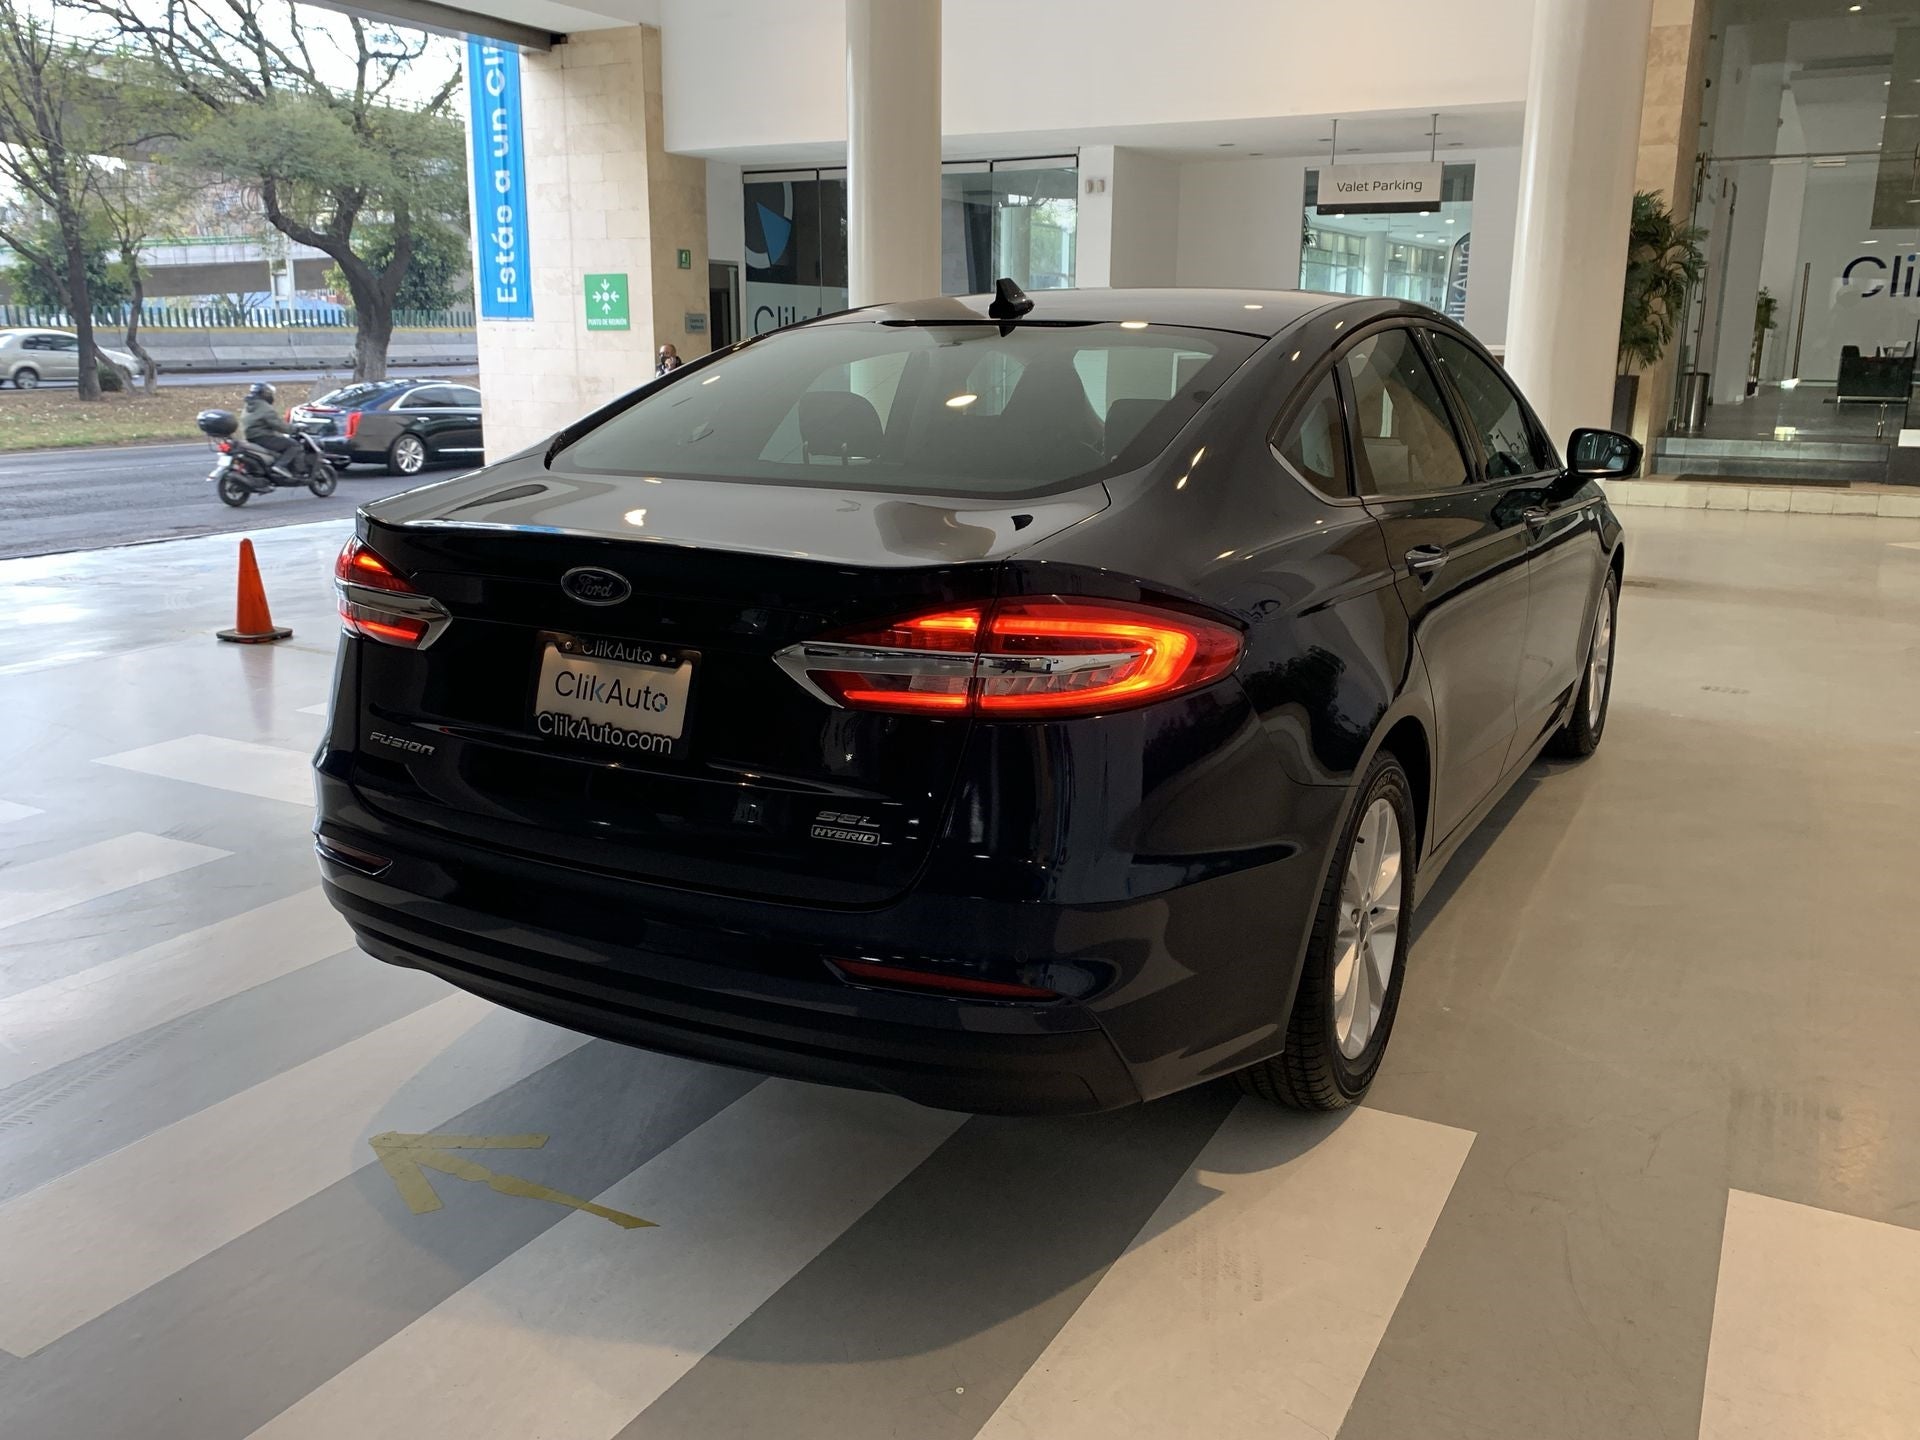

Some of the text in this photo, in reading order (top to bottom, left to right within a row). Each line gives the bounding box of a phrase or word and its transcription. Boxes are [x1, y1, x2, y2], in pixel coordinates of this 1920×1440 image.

[491, 108, 509, 158] un
[495, 169, 511, 194] a
[1336, 180, 1424, 193] Valet Parking
[491, 205, 518, 303] Estás
[1842, 254, 1920, 298] Cli
[575, 573, 614, 597] Ford
[555, 671, 668, 713] ClikAuto
[369, 731, 436, 756] FUSION
[537, 713, 673, 755] ClikAuto.com
[816, 811, 880, 827] SEL
[814, 828, 876, 842] HYBRID
